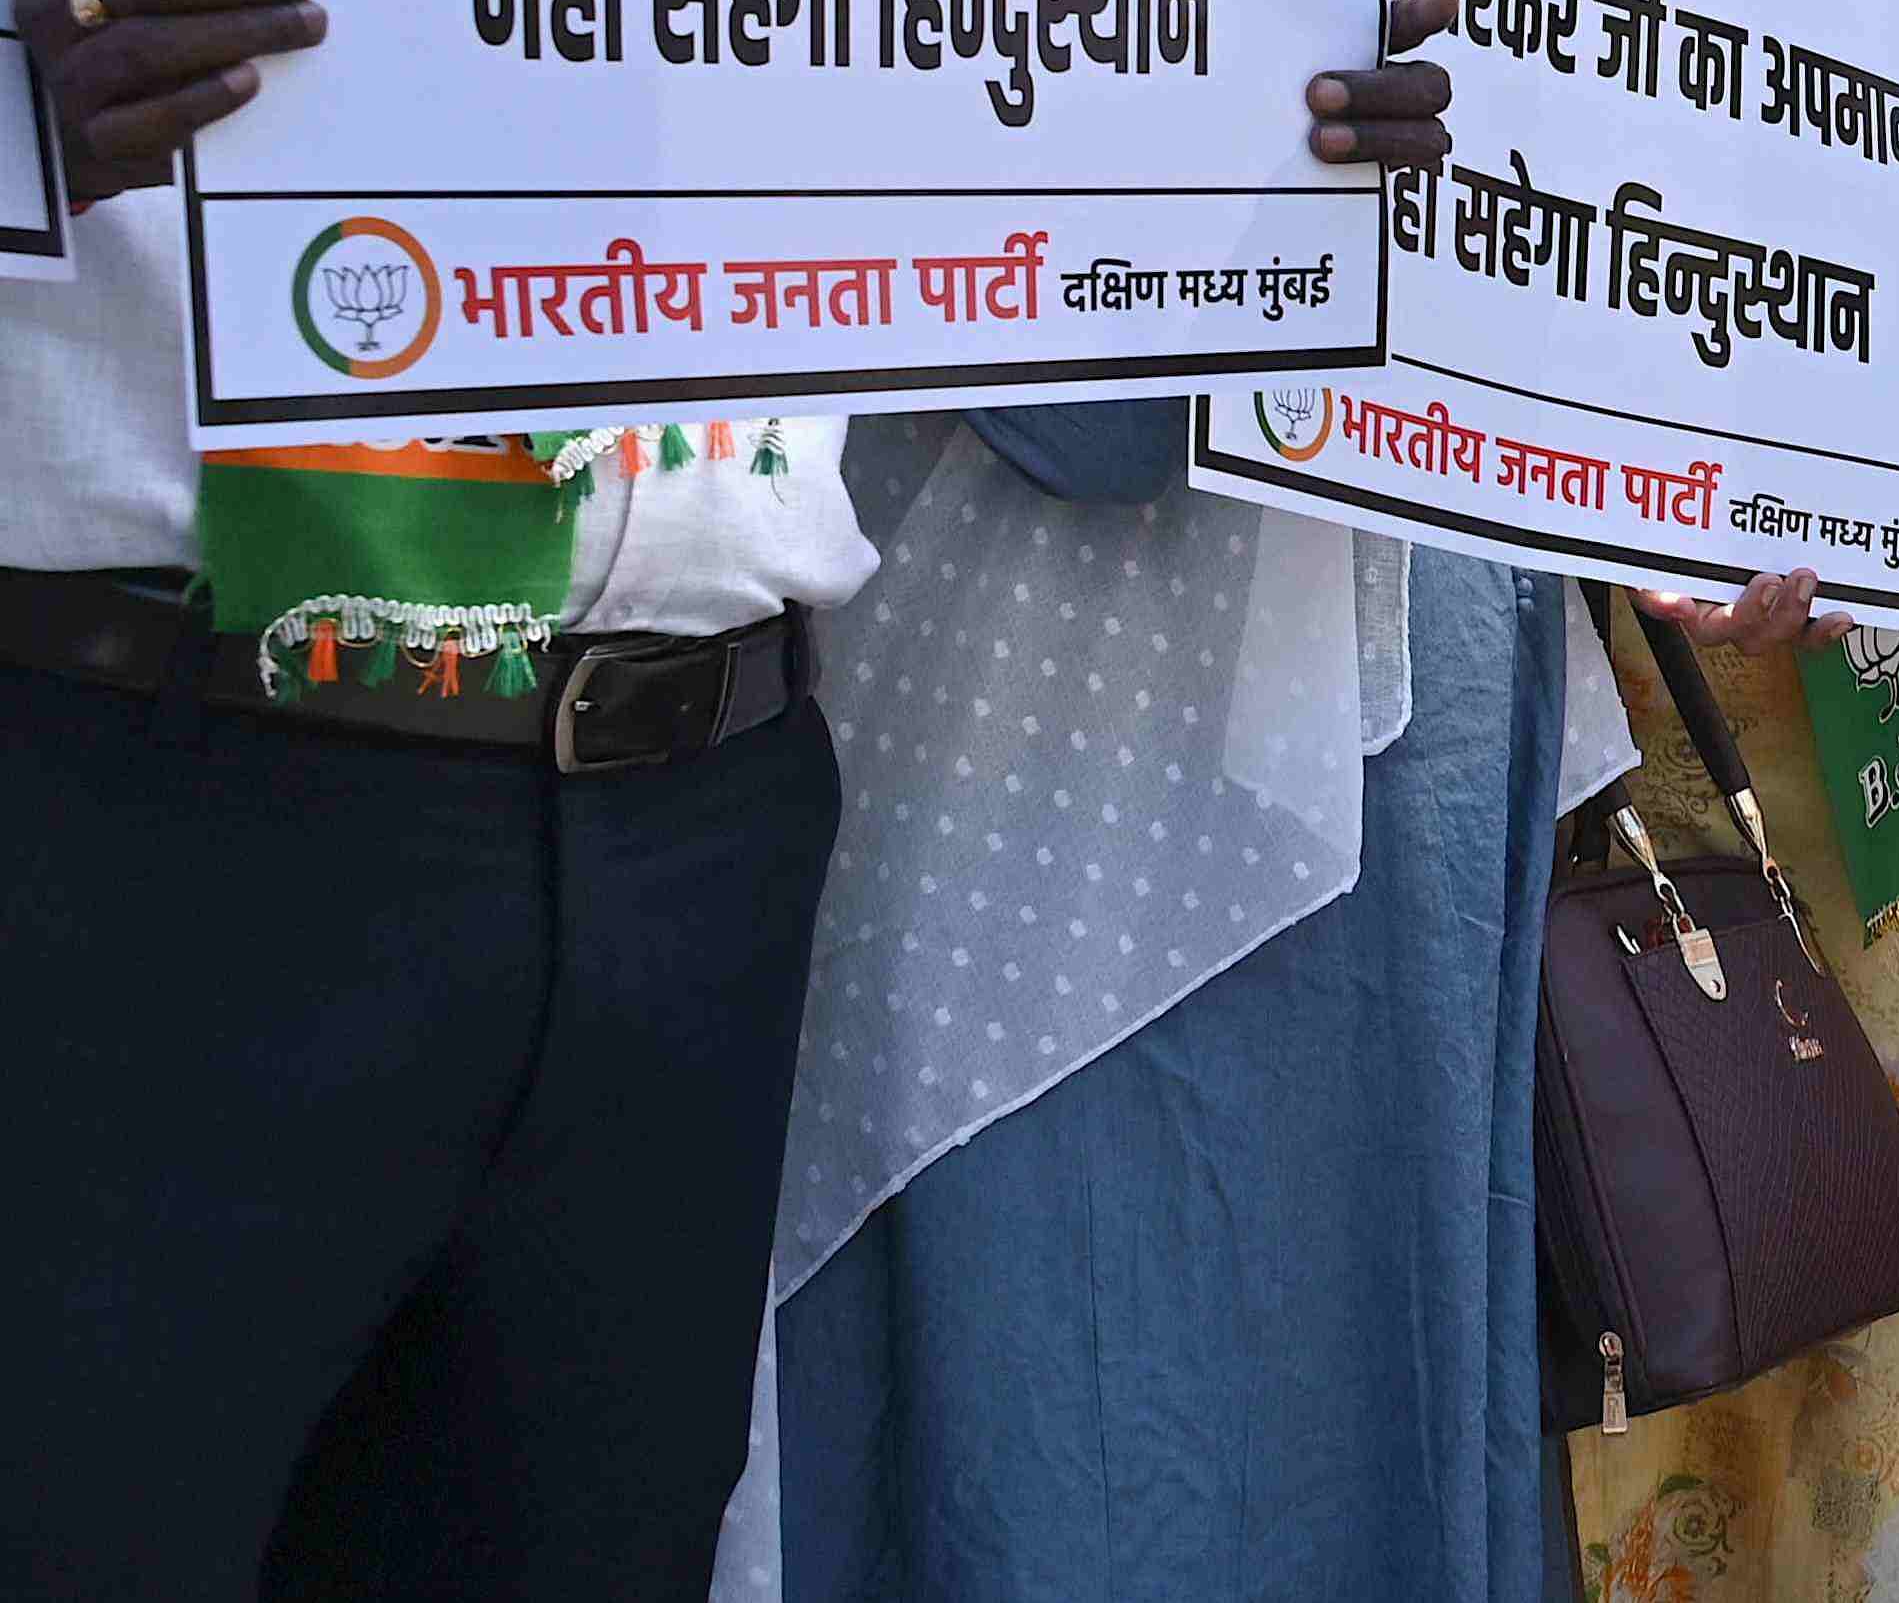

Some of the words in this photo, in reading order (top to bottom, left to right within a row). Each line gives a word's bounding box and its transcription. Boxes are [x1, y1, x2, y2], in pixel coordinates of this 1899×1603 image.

[1676, 5, 1748, 120] का
[455, 238, 706, 338] भारतीय
[724, 257, 897, 329] जनता
[913, 231, 1048, 321] पार्टी
[1062, 258, 1164, 311] दक्षिण
[1177, 269, 1247, 308] मध्य
[1256, 254, 1333, 322] मुंबई
[1453, 149, 1596, 301] सहेगा
[1606, 183, 1876, 368] हिन्दुस्थान
[1342, 395, 1484, 485] भारतीय
[1496, 440, 1609, 511] जनता
[1621, 462, 1723, 529] पार्टी
[1730, 492, 1810, 543] दक्षिण
[1820, 515, 1873, 553] मध्य
